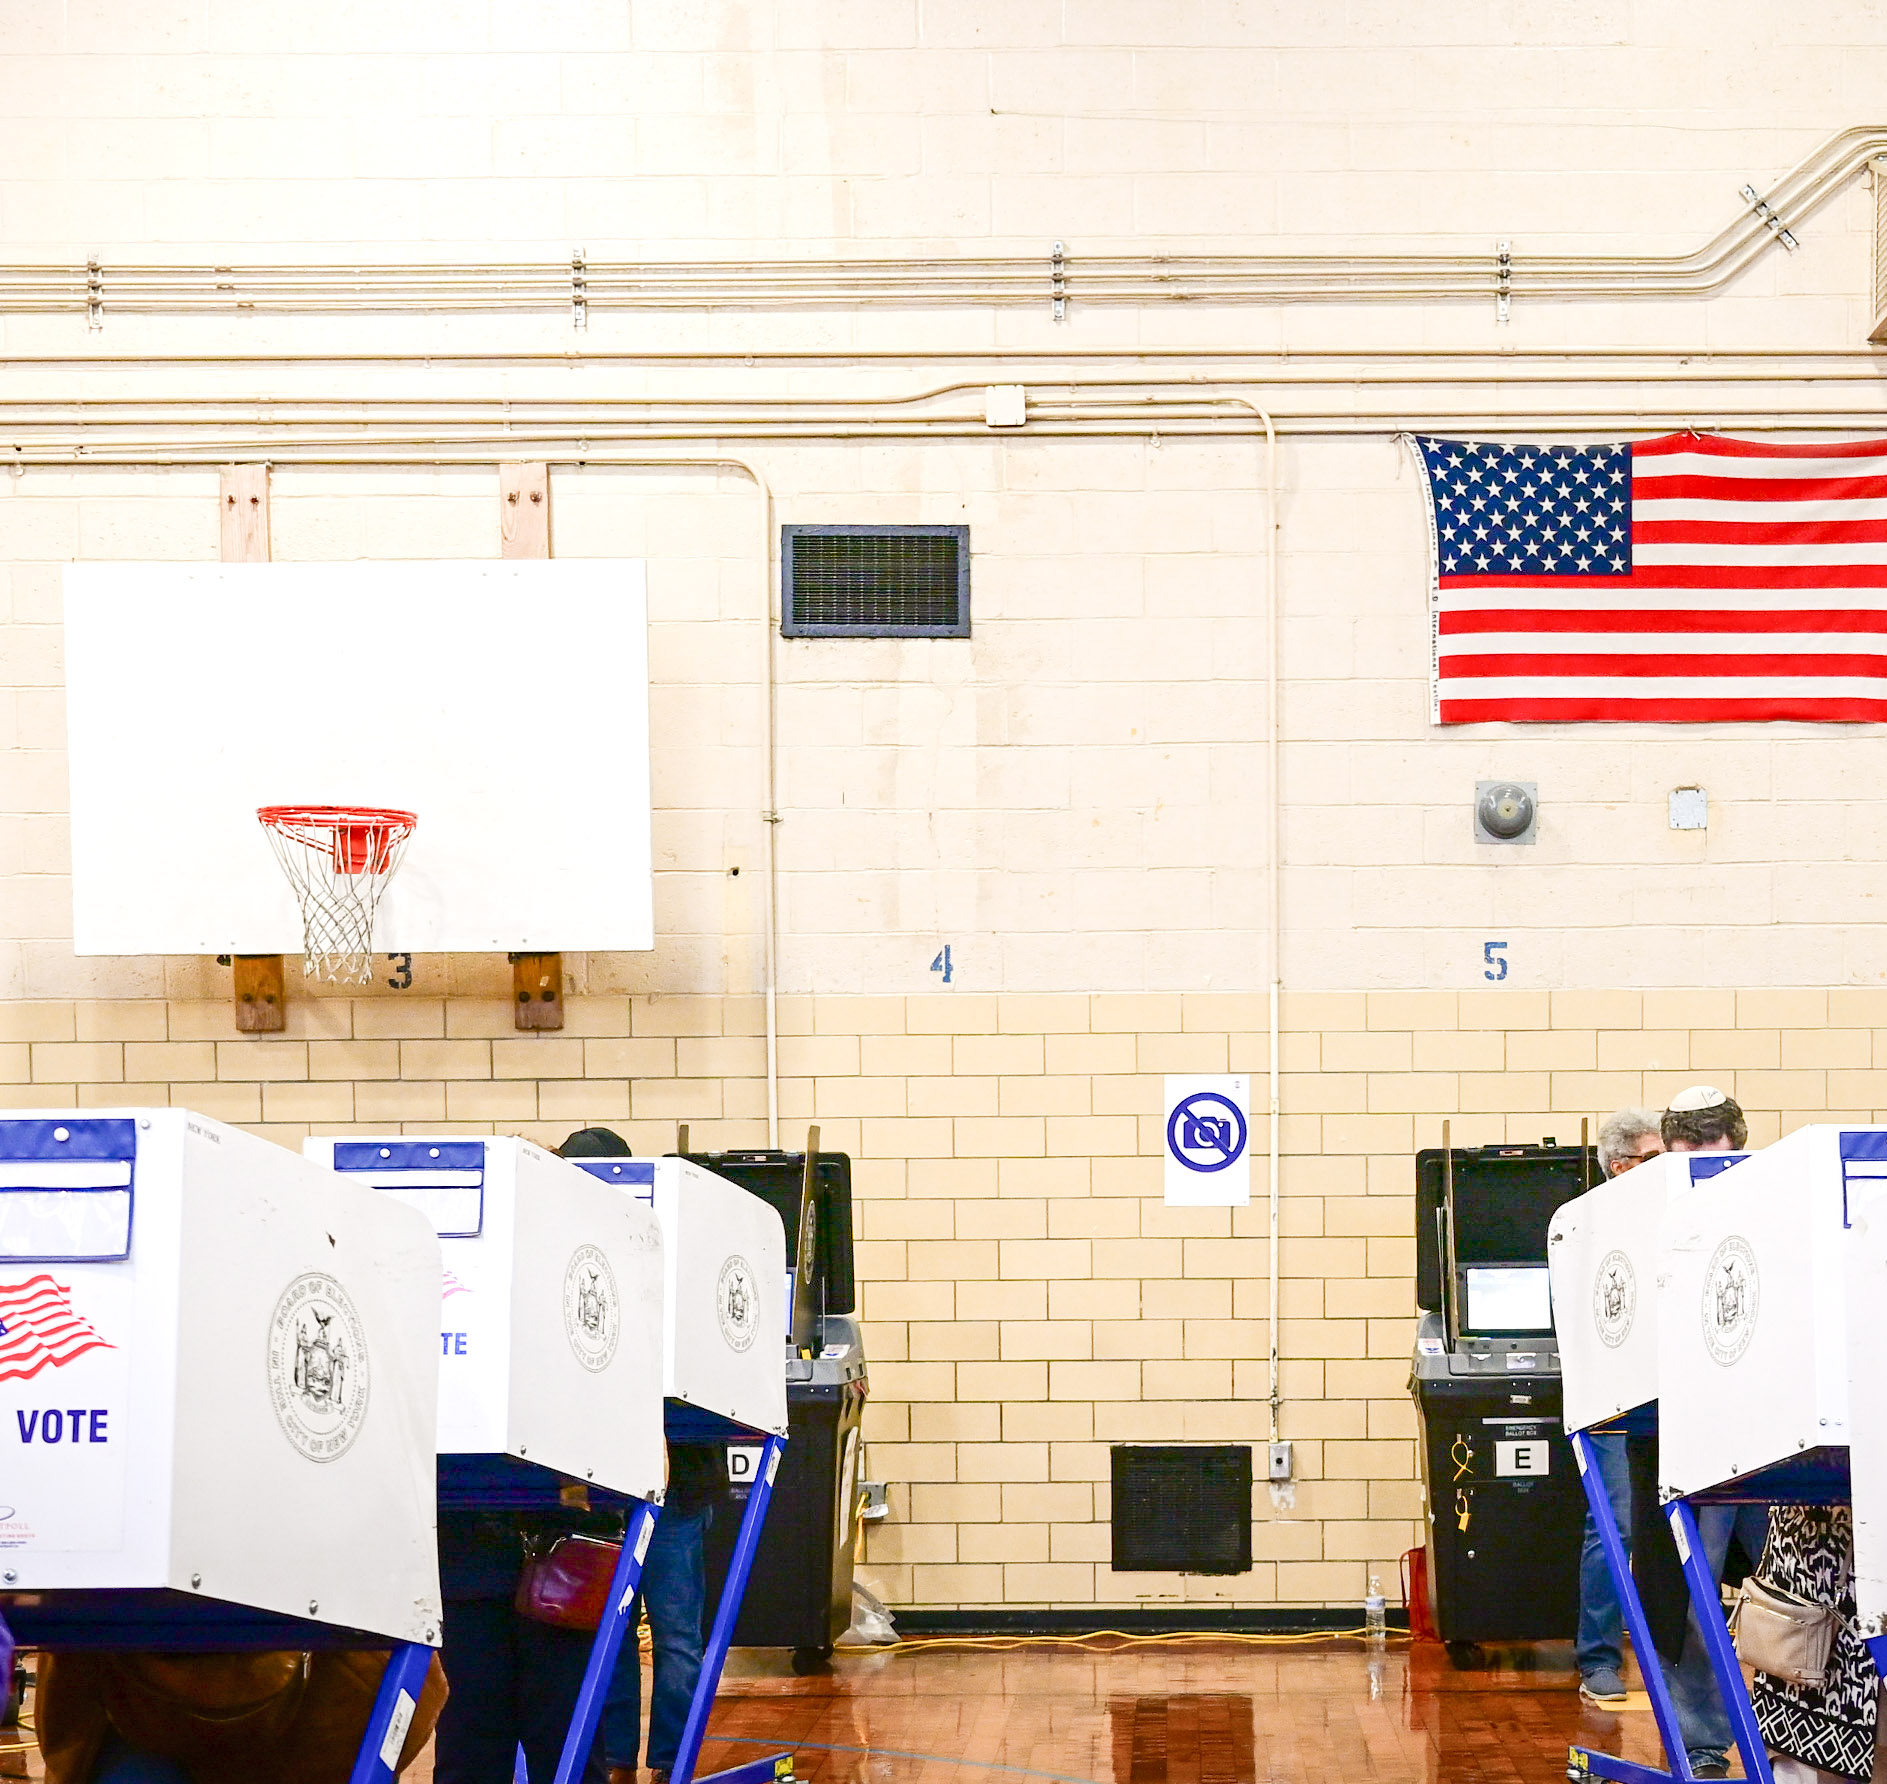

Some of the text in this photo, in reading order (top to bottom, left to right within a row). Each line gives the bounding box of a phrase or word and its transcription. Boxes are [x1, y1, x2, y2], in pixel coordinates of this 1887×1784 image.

[388, 953, 412, 989] 3
[930, 944, 953, 983] 4
[1483, 942, 1508, 980] 5
[440, 1332, 467, 1355] TE
[17, 1409, 108, 1443] VOTE
[732, 1454, 750, 1475] D
[1515, 1448, 1531, 1469] E
